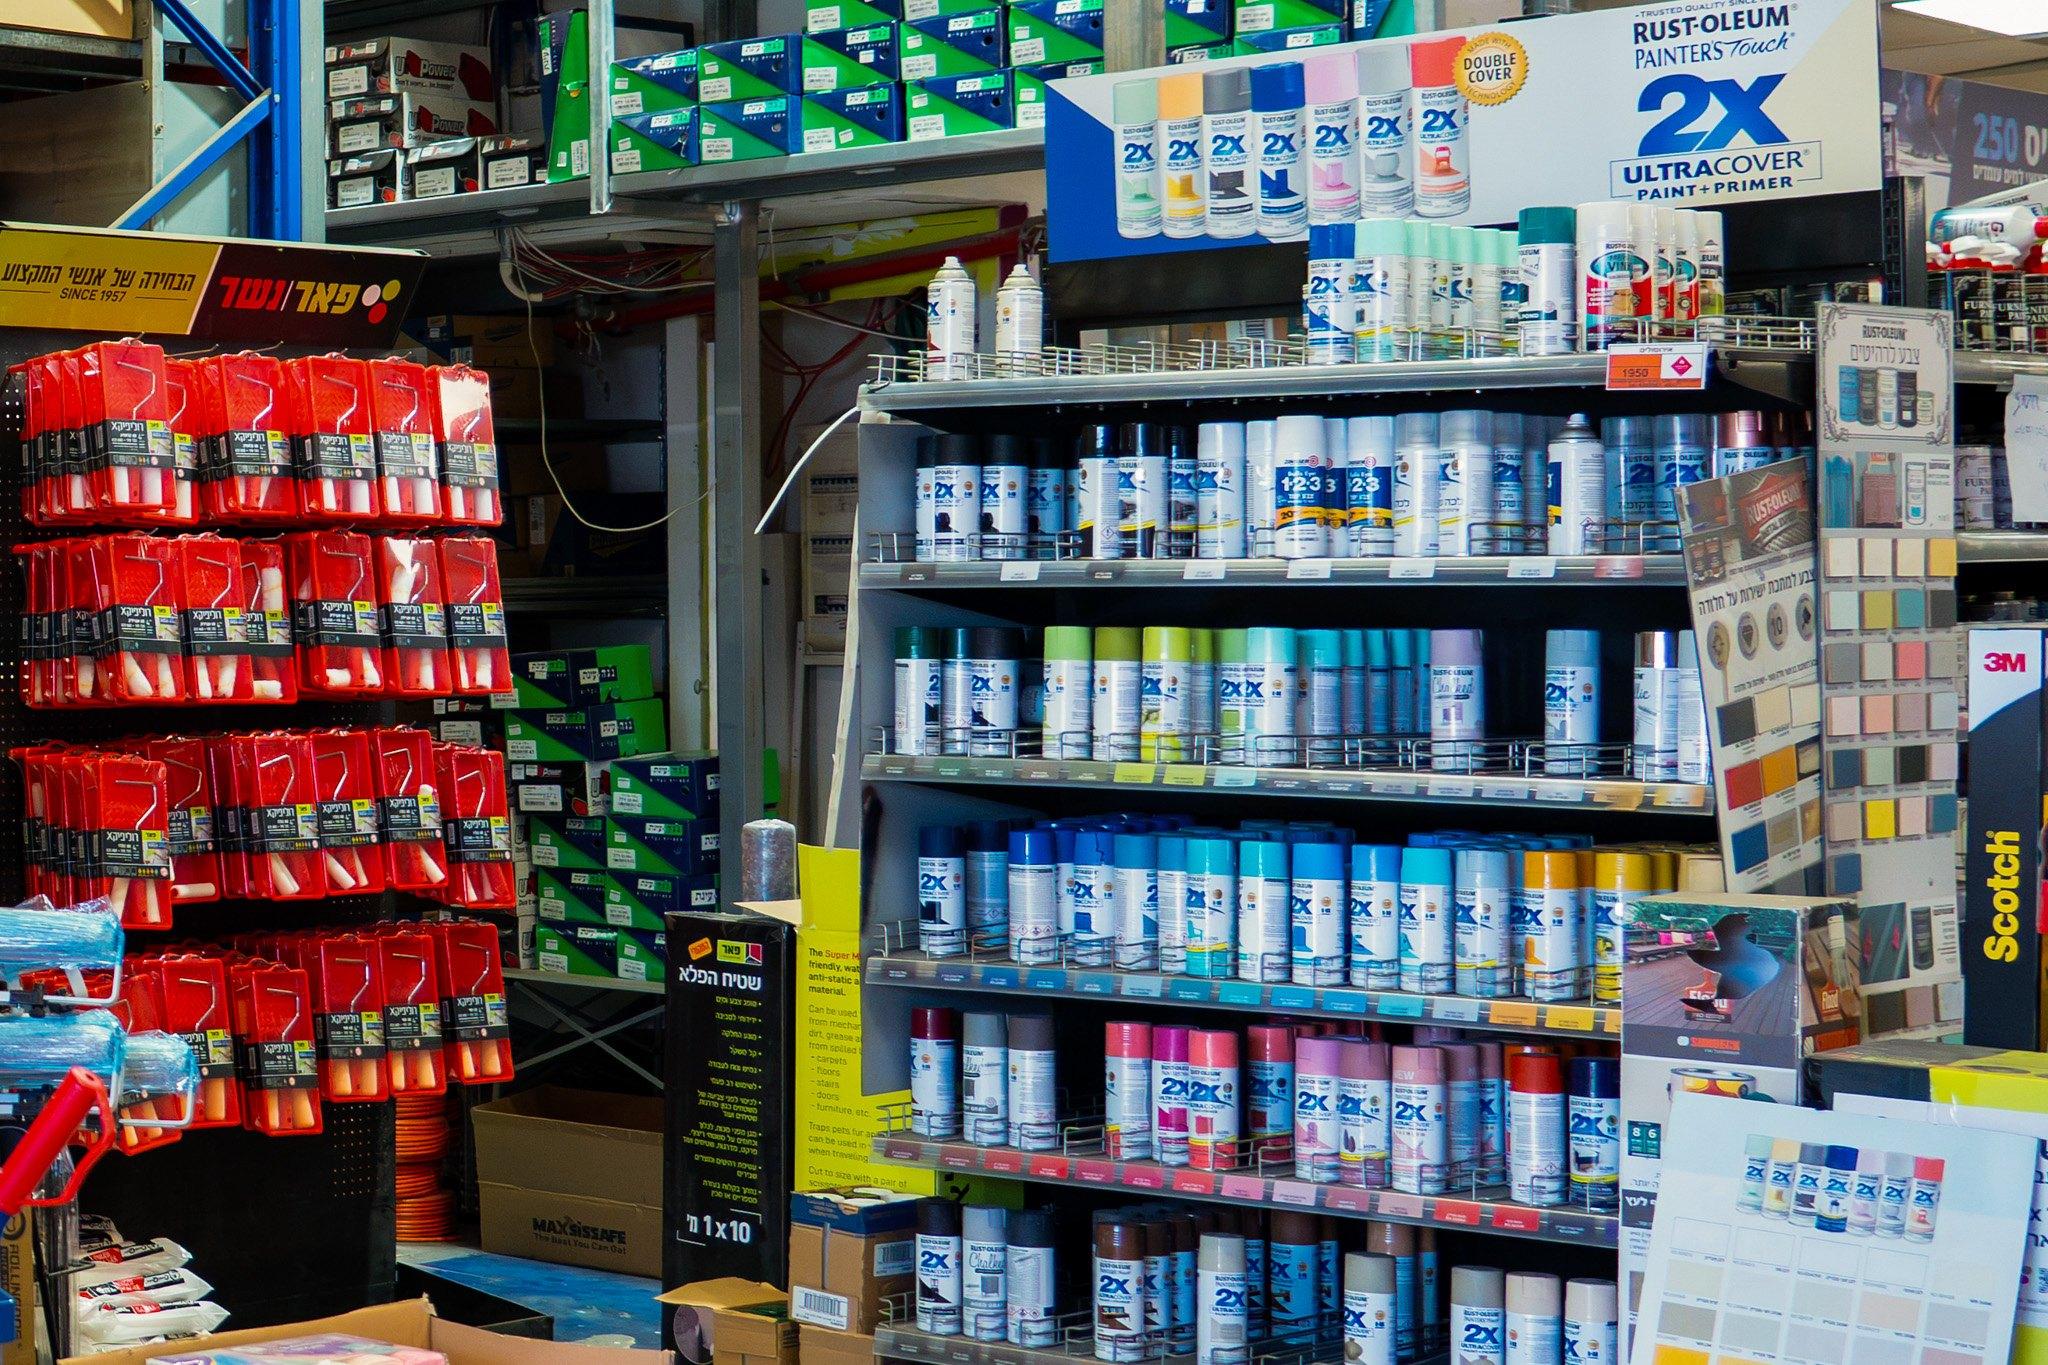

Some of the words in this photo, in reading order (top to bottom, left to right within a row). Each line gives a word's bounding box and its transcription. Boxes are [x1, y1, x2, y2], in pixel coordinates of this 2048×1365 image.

[1640, 6, 1682, 18] TRUSTED
[1684, 1, 1725, 13] QUALITY
[1633, 5, 1790, 45] RUST-OLEUM
[1491, 38, 1510, 49] WITH
[1635, 41, 1723, 70] PAINTER'S
[1723, 31, 1789, 58] Touch
[1464, 52, 1517, 70] DOUBLE
[1467, 67, 1511, 83] COVER
[1465, 81, 1516, 101] TECHNOLOGY
[1422, 108, 1458, 132] 2X
[1637, 73, 1790, 157] 2X
[1315, 124, 1349, 147] 2X
[1367, 115, 1403, 138] 2X
[1212, 134, 1247, 156] 2X
[1263, 132, 1296, 155] 2X
[1973, 111, 2019, 163] 250
[1123, 143, 1153, 163] 2X
[1168, 139, 1200, 161] 2X
[1623, 150, 1803, 185] ULTRACOVER
[1, 263, 62, 286] המקצוע
[67, 266, 103, 287] אנשי
[111, 268, 134, 288] של
[139, 271, 197, 292] הבחירה
[219, 276, 286, 310] נשר
[1310, 275, 1341, 294] 2X
[60, 287, 98, 301] SINCE
[100, 288, 127, 302] 1957
[295, 280, 362, 315] פאר
[1850, 344, 1896, 364] לרהיטים
[1899, 348, 1920, 365] צבע
[1622, 368, 1649, 378] 1950
[1740, 584, 1767, 604] ישירות
[1768, 575, 1798, 596] למתכת
[1698, 595, 1725, 616] חלודה
[1726, 590, 1738, 607] על
[1983, 652, 2027, 673] 3M
[929, 674, 940, 691] 2
[920, 872, 947, 891] 2X
[1146, 884, 1158, 902] 2
[1983, 831, 2021, 963] Scotch
[722, 944, 741, 955] פאר
[808, 948, 823, 957] The
[825, 949, 850, 960] Super
[679, 965, 717, 986] הפלא
[722, 971, 761, 990] שטיח
[808, 973, 853, 984] anti-static
[808, 1004, 825, 1014] Can
[826, 1005, 836, 1015] be
[839, 1008, 858, 1018] used
[808, 1016, 828, 1026] from
[808, 1042, 828, 1051] from
[826, 1033, 852, 1043] grease
[817, 1055, 848, 1067] carpets
[817, 1066, 840, 1077] floors
[817, 1079, 840, 1088] stairs
[1161, 1077, 1189, 1095] 2X
[1191, 1081, 1221, 1102] 2X
[817, 1091, 840, 1101] doors
[1298, 1091, 1329, 1112] 2X
[1395, 1100, 1427, 1121] 2X
[808, 1121, 830, 1133] Traps
[852, 1127, 864, 1137] fur
[1632, 1127, 1641, 1137] 8
[1648, 1129, 1657, 1139] 6
[808, 1135, 824, 1143] can
[825, 1136, 835, 1145] be
[837, 1139, 857, 1148] used
[808, 1147, 831, 1156] when
[808, 1166, 823, 1176] Cut
[824, 1168, 834, 1177] to
[835, 1170, 852, 1180] size
[853, 1172, 871, 1182] with
[873, 1177, 879, 1185] a
[880, 1178, 896, 1187] pair
[898, 1179, 907, 1187] of
[1747, 1165, 1765, 1179] 2X
[1771, 1170, 1790, 1184] 2X
[1800, 1173, 1819, 1188] 2X
[1826, 1177, 1850, 1192] 2X
[1855, 1182, 1876, 1197] 2X
[1885, 1185, 1905, 1200] 2X
[1915, 1190, 1934, 1204] 2X
[920, 1250, 949, 1269] 2X
[969, 1252, 1006, 1269] Chalke
[1100, 1275, 1131, 1295] 2X
[1215, 1289, 1246, 1307] 2X
[1464, 1324, 1499, 1344] 2X
